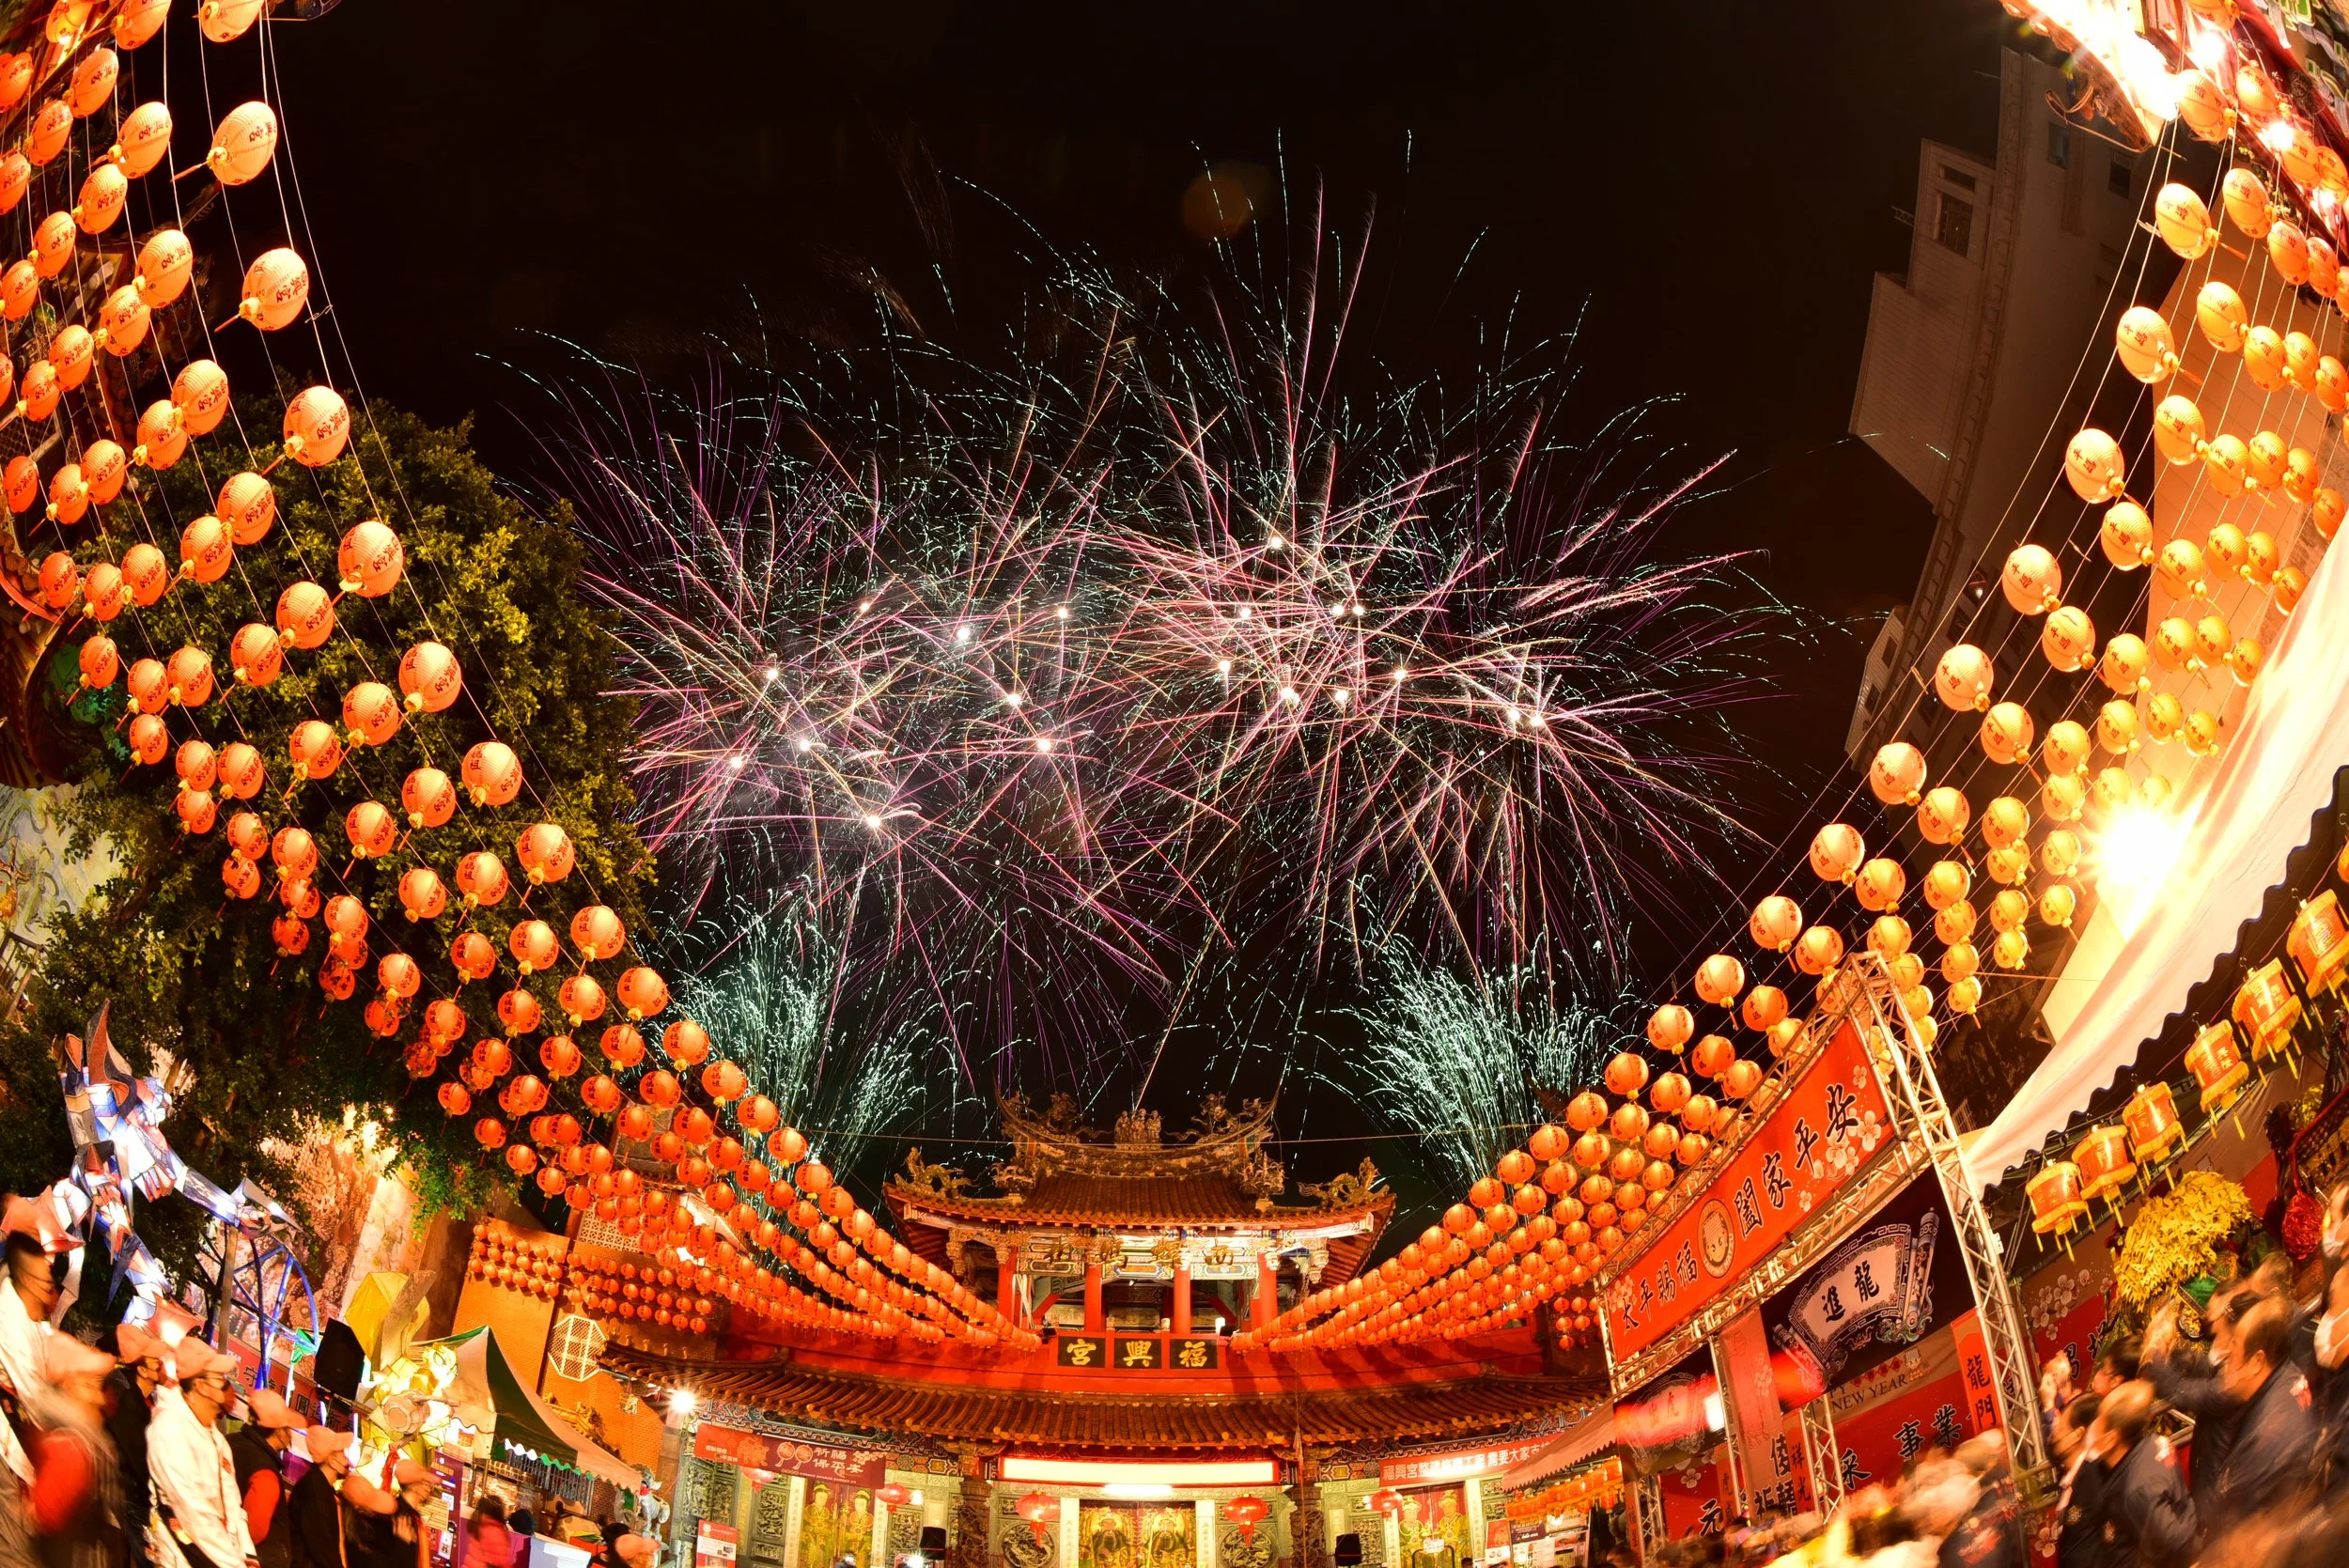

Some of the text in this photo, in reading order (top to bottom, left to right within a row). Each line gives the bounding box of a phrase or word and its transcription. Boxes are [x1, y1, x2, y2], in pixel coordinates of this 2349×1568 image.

[1734, 1083, 1859, 1240] 闔家平安
[1831, 1389, 1866, 1413] NEW
[1869, 1373, 1908, 1399] YEAR
